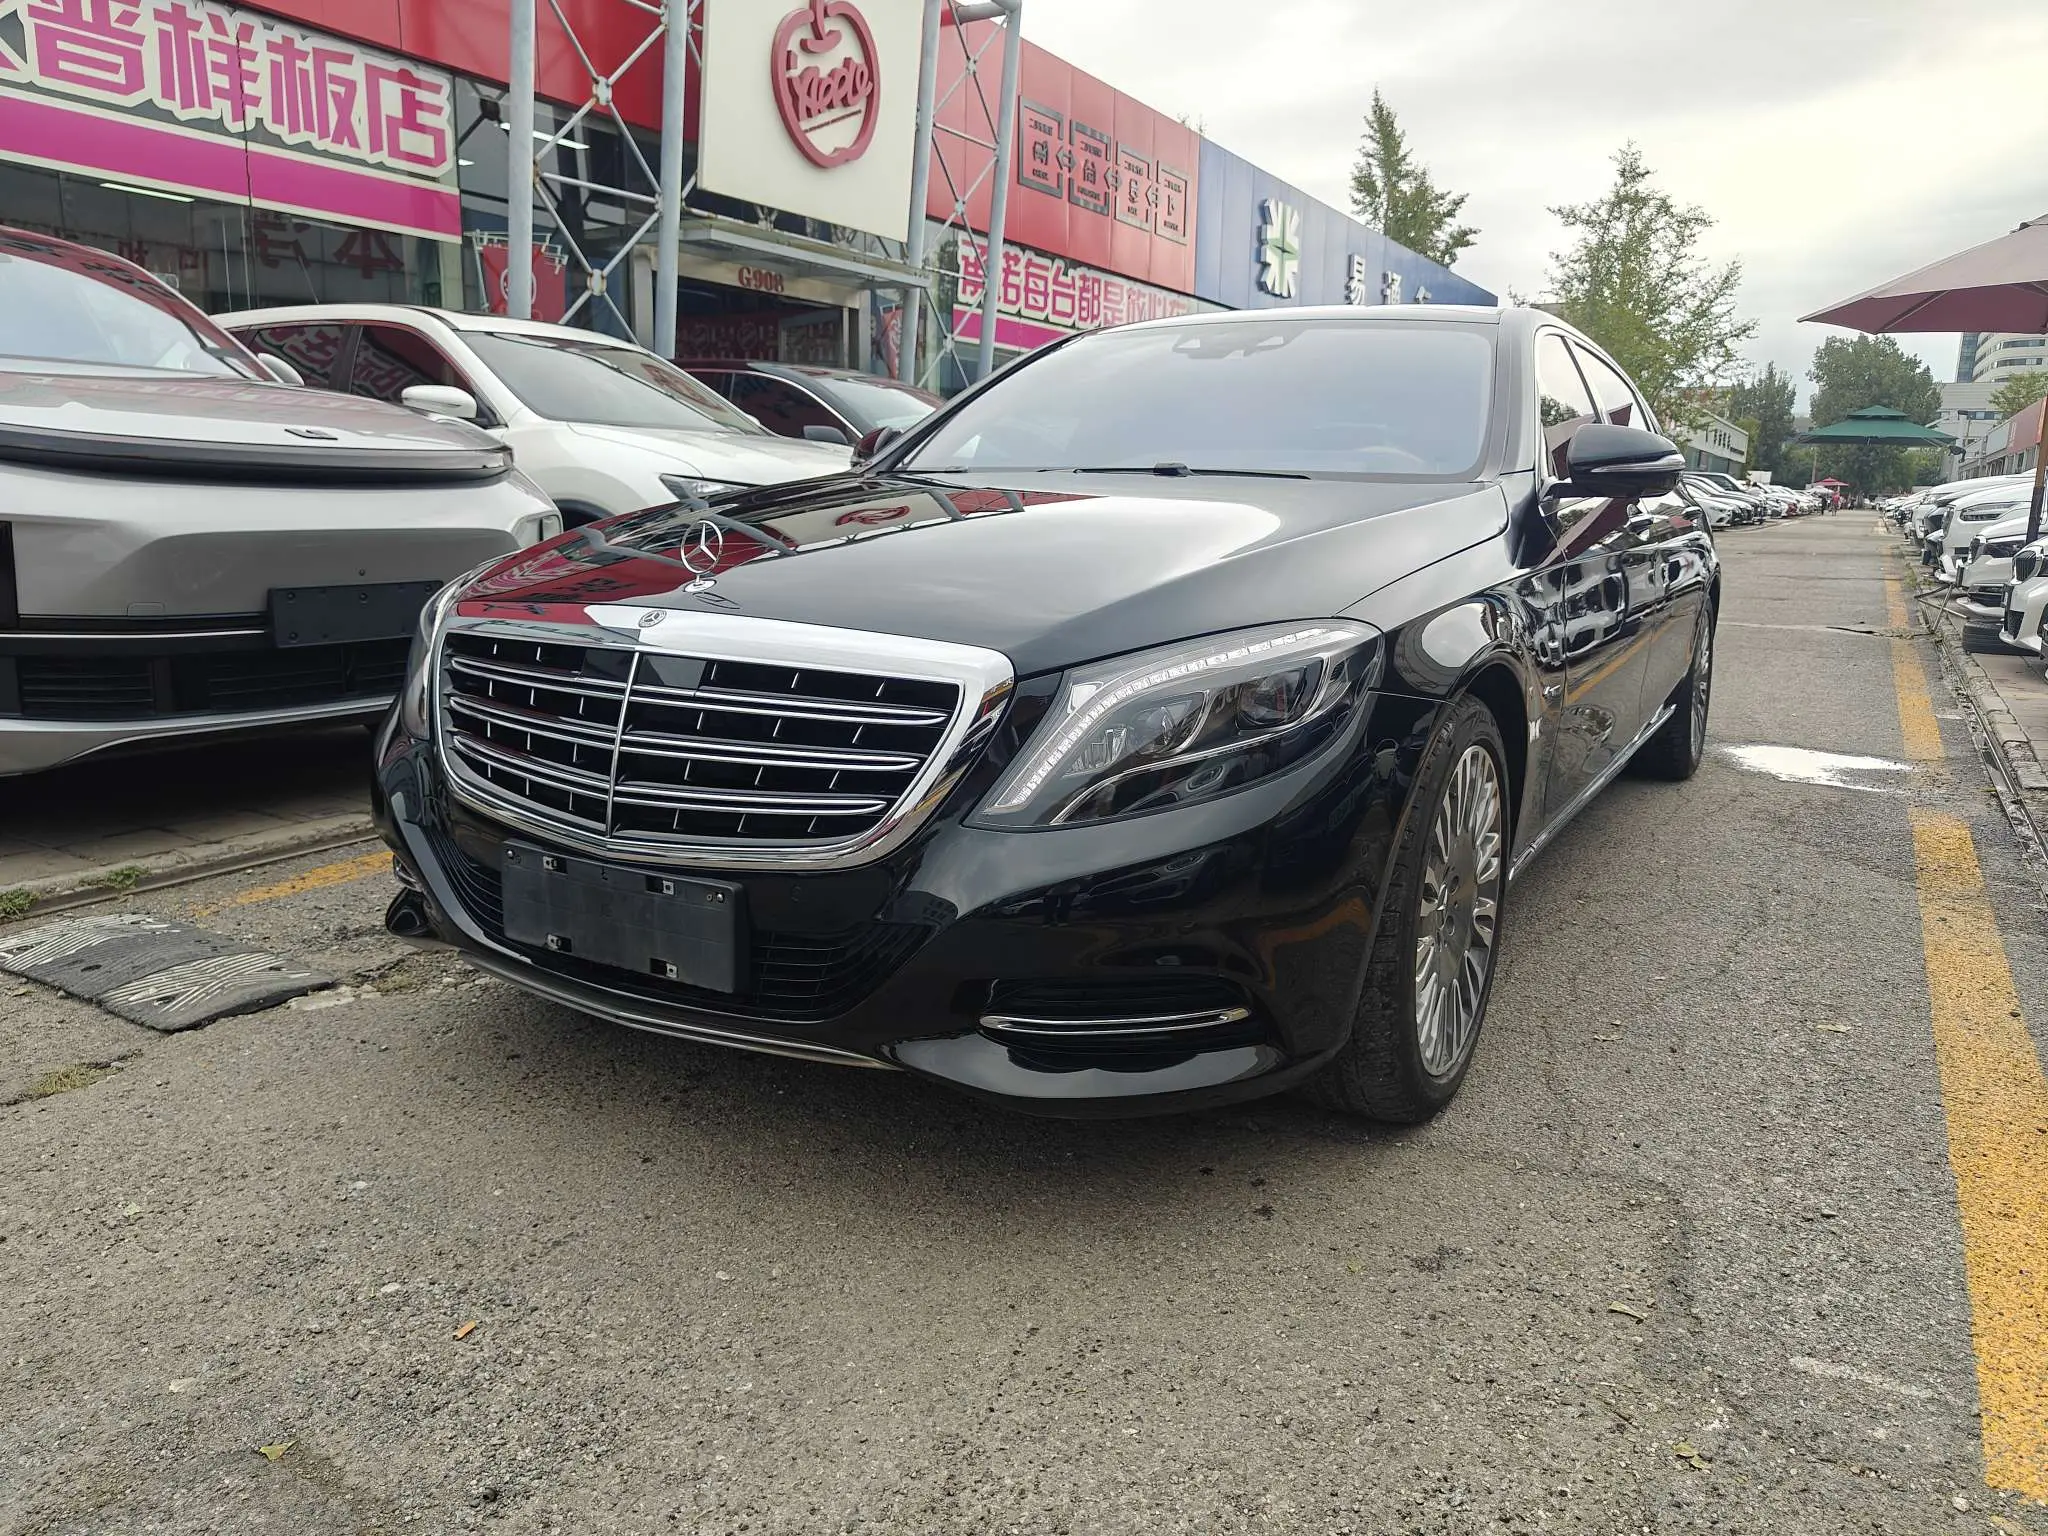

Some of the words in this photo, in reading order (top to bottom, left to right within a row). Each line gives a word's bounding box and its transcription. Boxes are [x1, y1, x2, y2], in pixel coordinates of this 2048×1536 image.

[0, 0, 447, 167] 普样板店
[738, 266, 784, 292] G908
